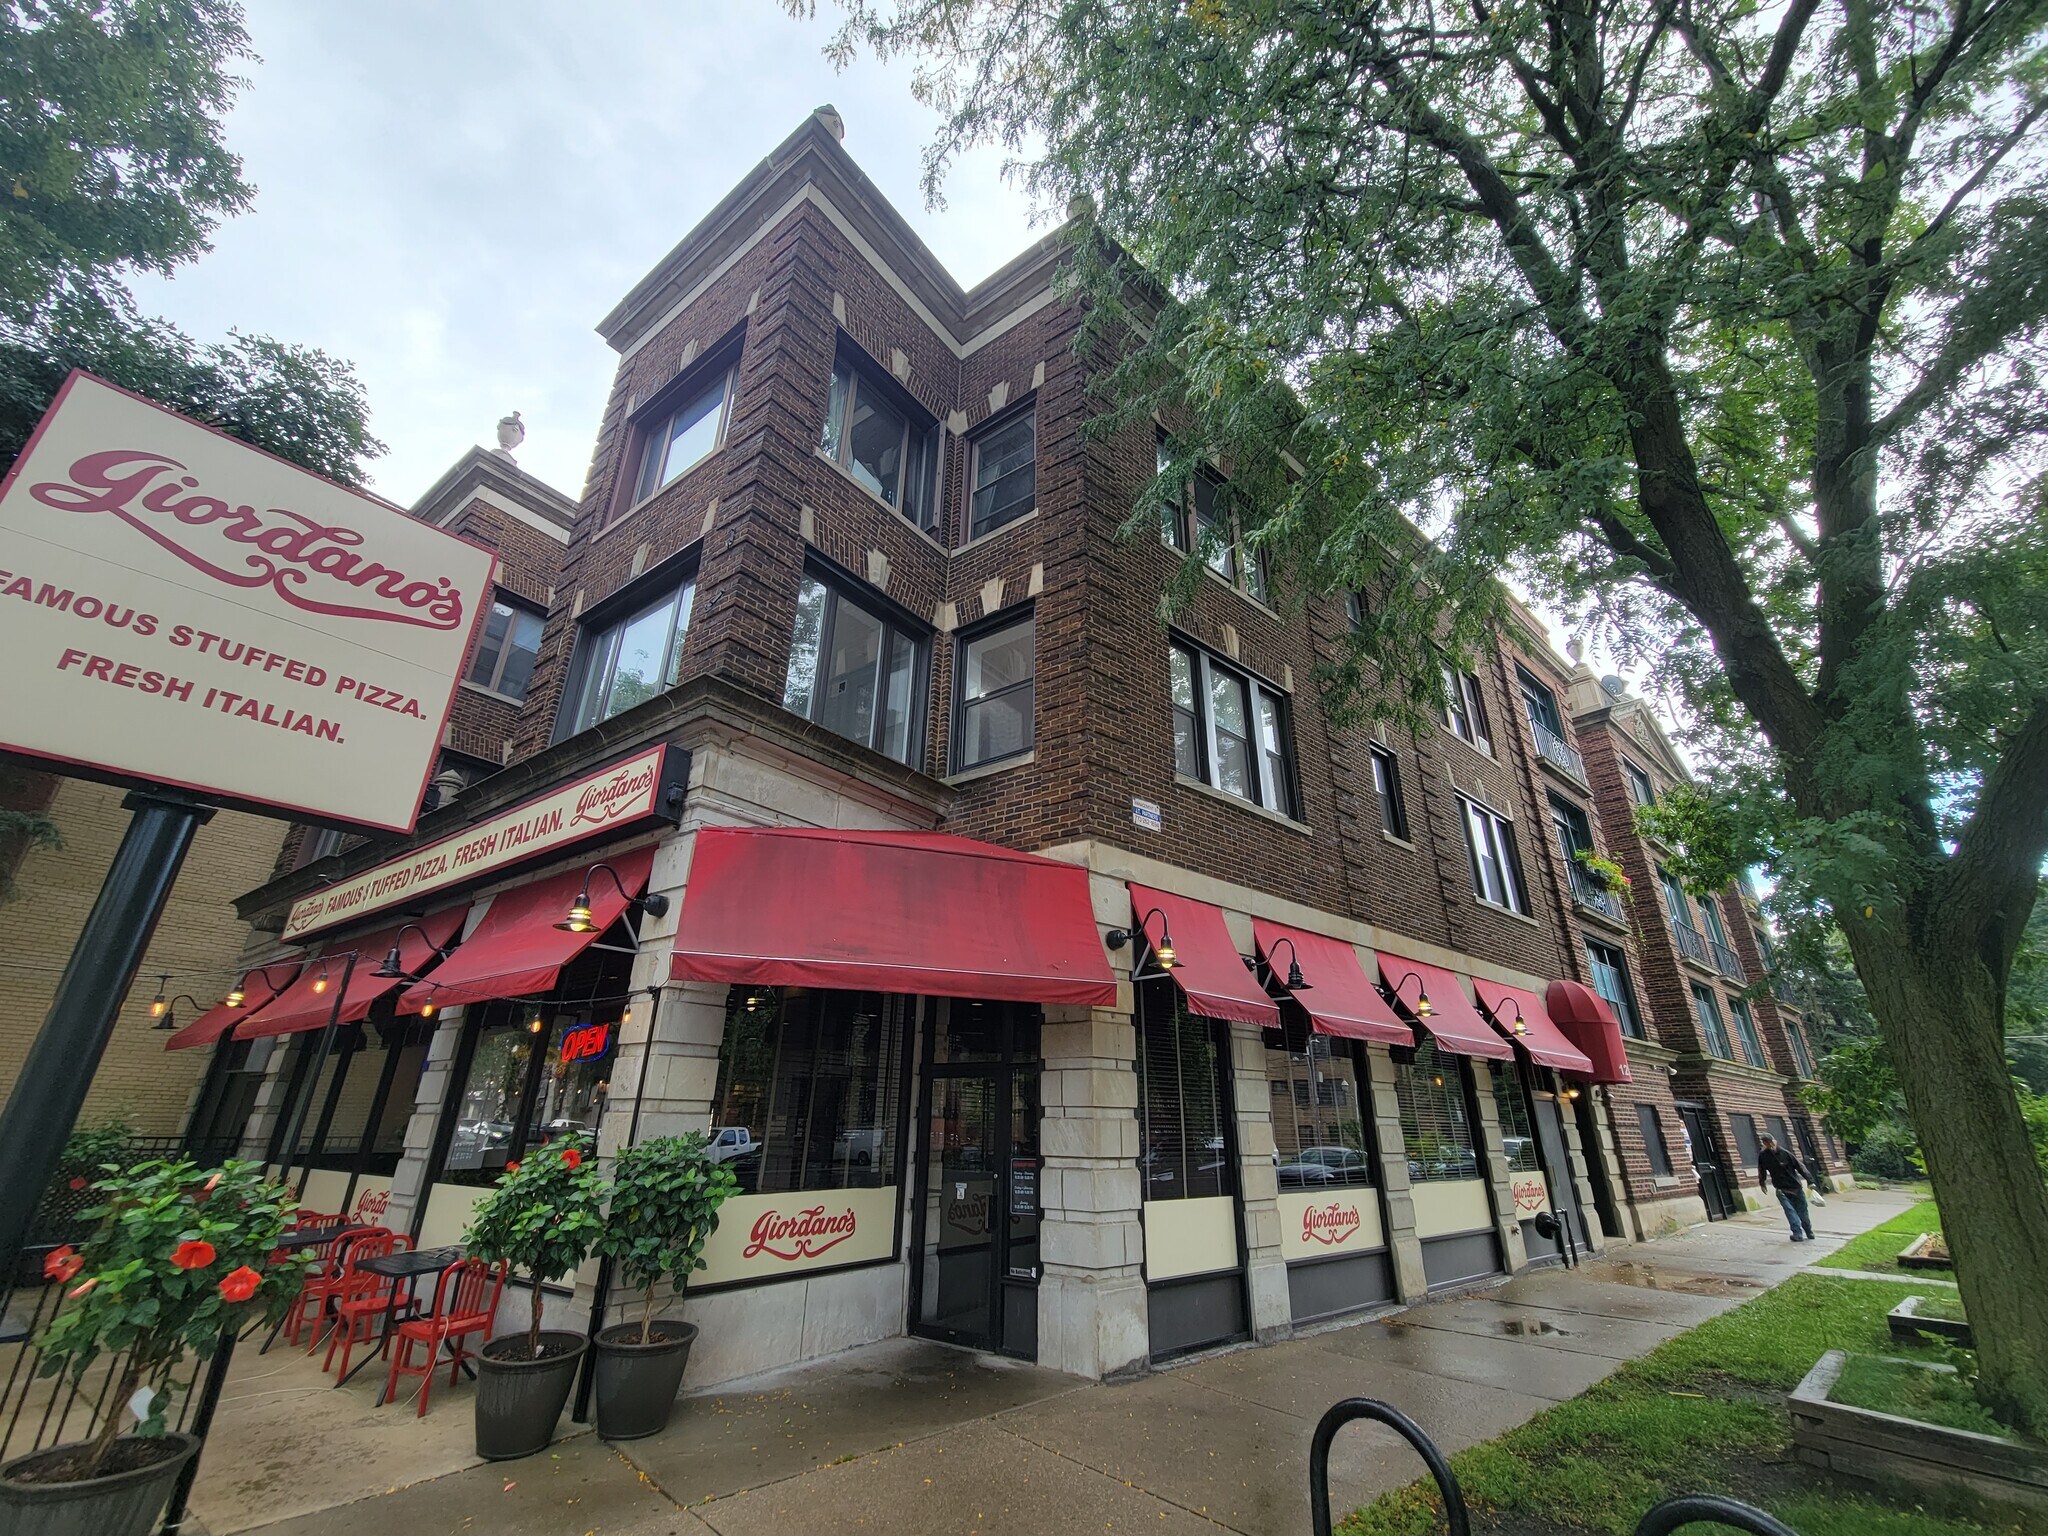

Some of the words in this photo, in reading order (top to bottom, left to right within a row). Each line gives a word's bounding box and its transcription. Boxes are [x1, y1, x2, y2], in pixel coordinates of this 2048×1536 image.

[29, 450, 463, 630] Giordano's
[0, 569, 159, 636] FAMOUS
[168, 624, 327, 687] STUFFED
[335, 675, 428, 721] PIZZA.
[56, 648, 195, 702] FRESH
[202, 687, 345, 744] ITALIAN.
[325, 885, 364, 915] FAMOUS
[362, 867, 411, 902] STUFFED
[410, 854, 448, 889] PIZZA.
[452, 832, 499, 869] FRESH
[499, 808, 563, 852] ITALIAN.
[570, 764, 654, 828] Giordano's
[562, 1023, 609, 1063] OPEN
[743, 1205, 856, 1261] Giordano's
[1302, 1203, 1360, 1245] Giordano's
[1513, 1180, 1545, 1211] Giordano's
